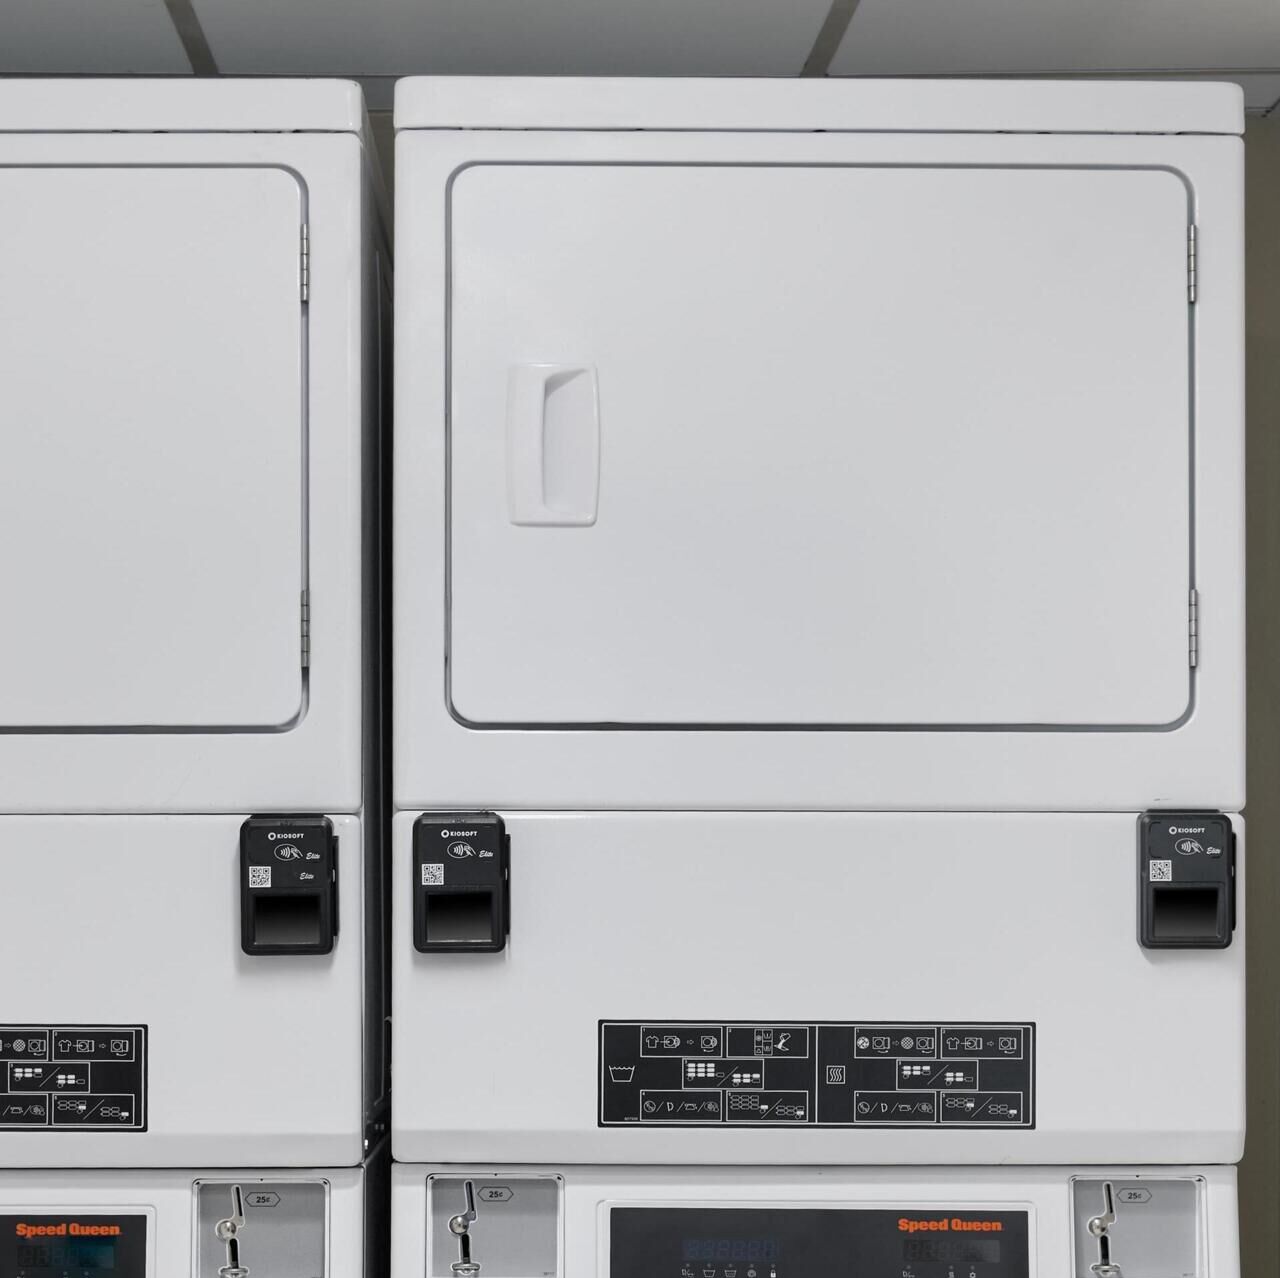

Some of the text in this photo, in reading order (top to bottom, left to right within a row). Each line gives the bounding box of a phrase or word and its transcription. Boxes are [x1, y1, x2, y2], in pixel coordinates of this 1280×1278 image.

[16, 1222, 120, 1239] Speed Queen
[898, 1218, 1002, 1233] Speed Queen
